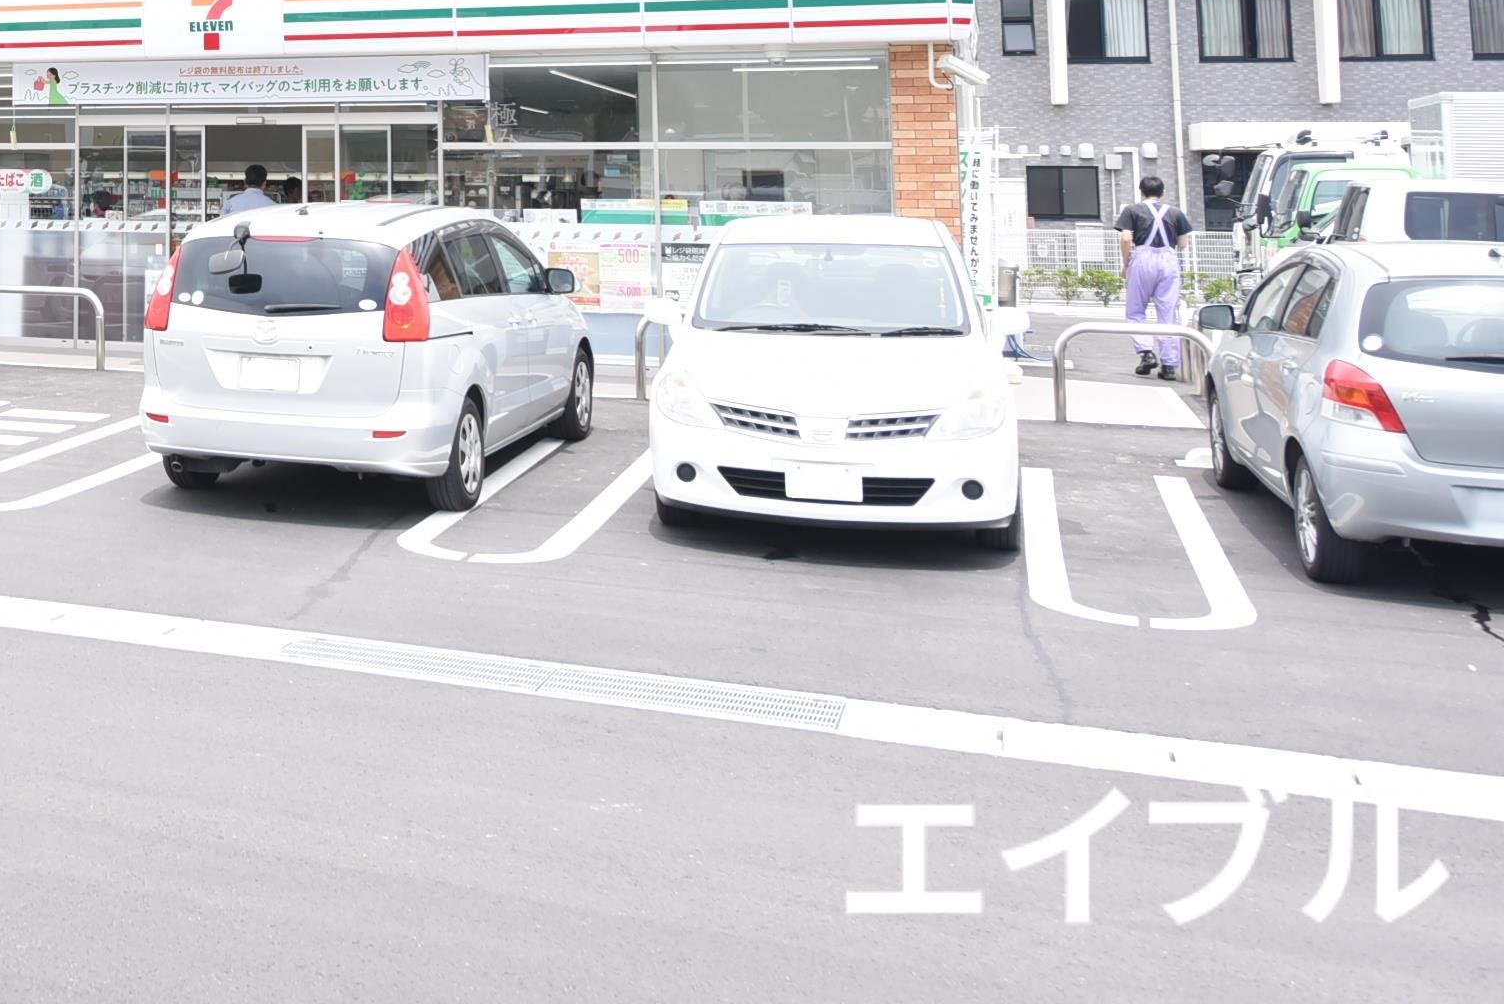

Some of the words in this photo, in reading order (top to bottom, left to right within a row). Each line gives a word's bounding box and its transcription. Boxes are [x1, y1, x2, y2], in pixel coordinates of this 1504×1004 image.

[179, 65, 304, 75] レジ袋の無料配布は終了しました。
[68, 77, 429, 95] プラスチック削減に向けて、マイバッグのご利用をお願いします。
[31, 173, 44, 187] 酒
[618, 249, 640, 264] 500
